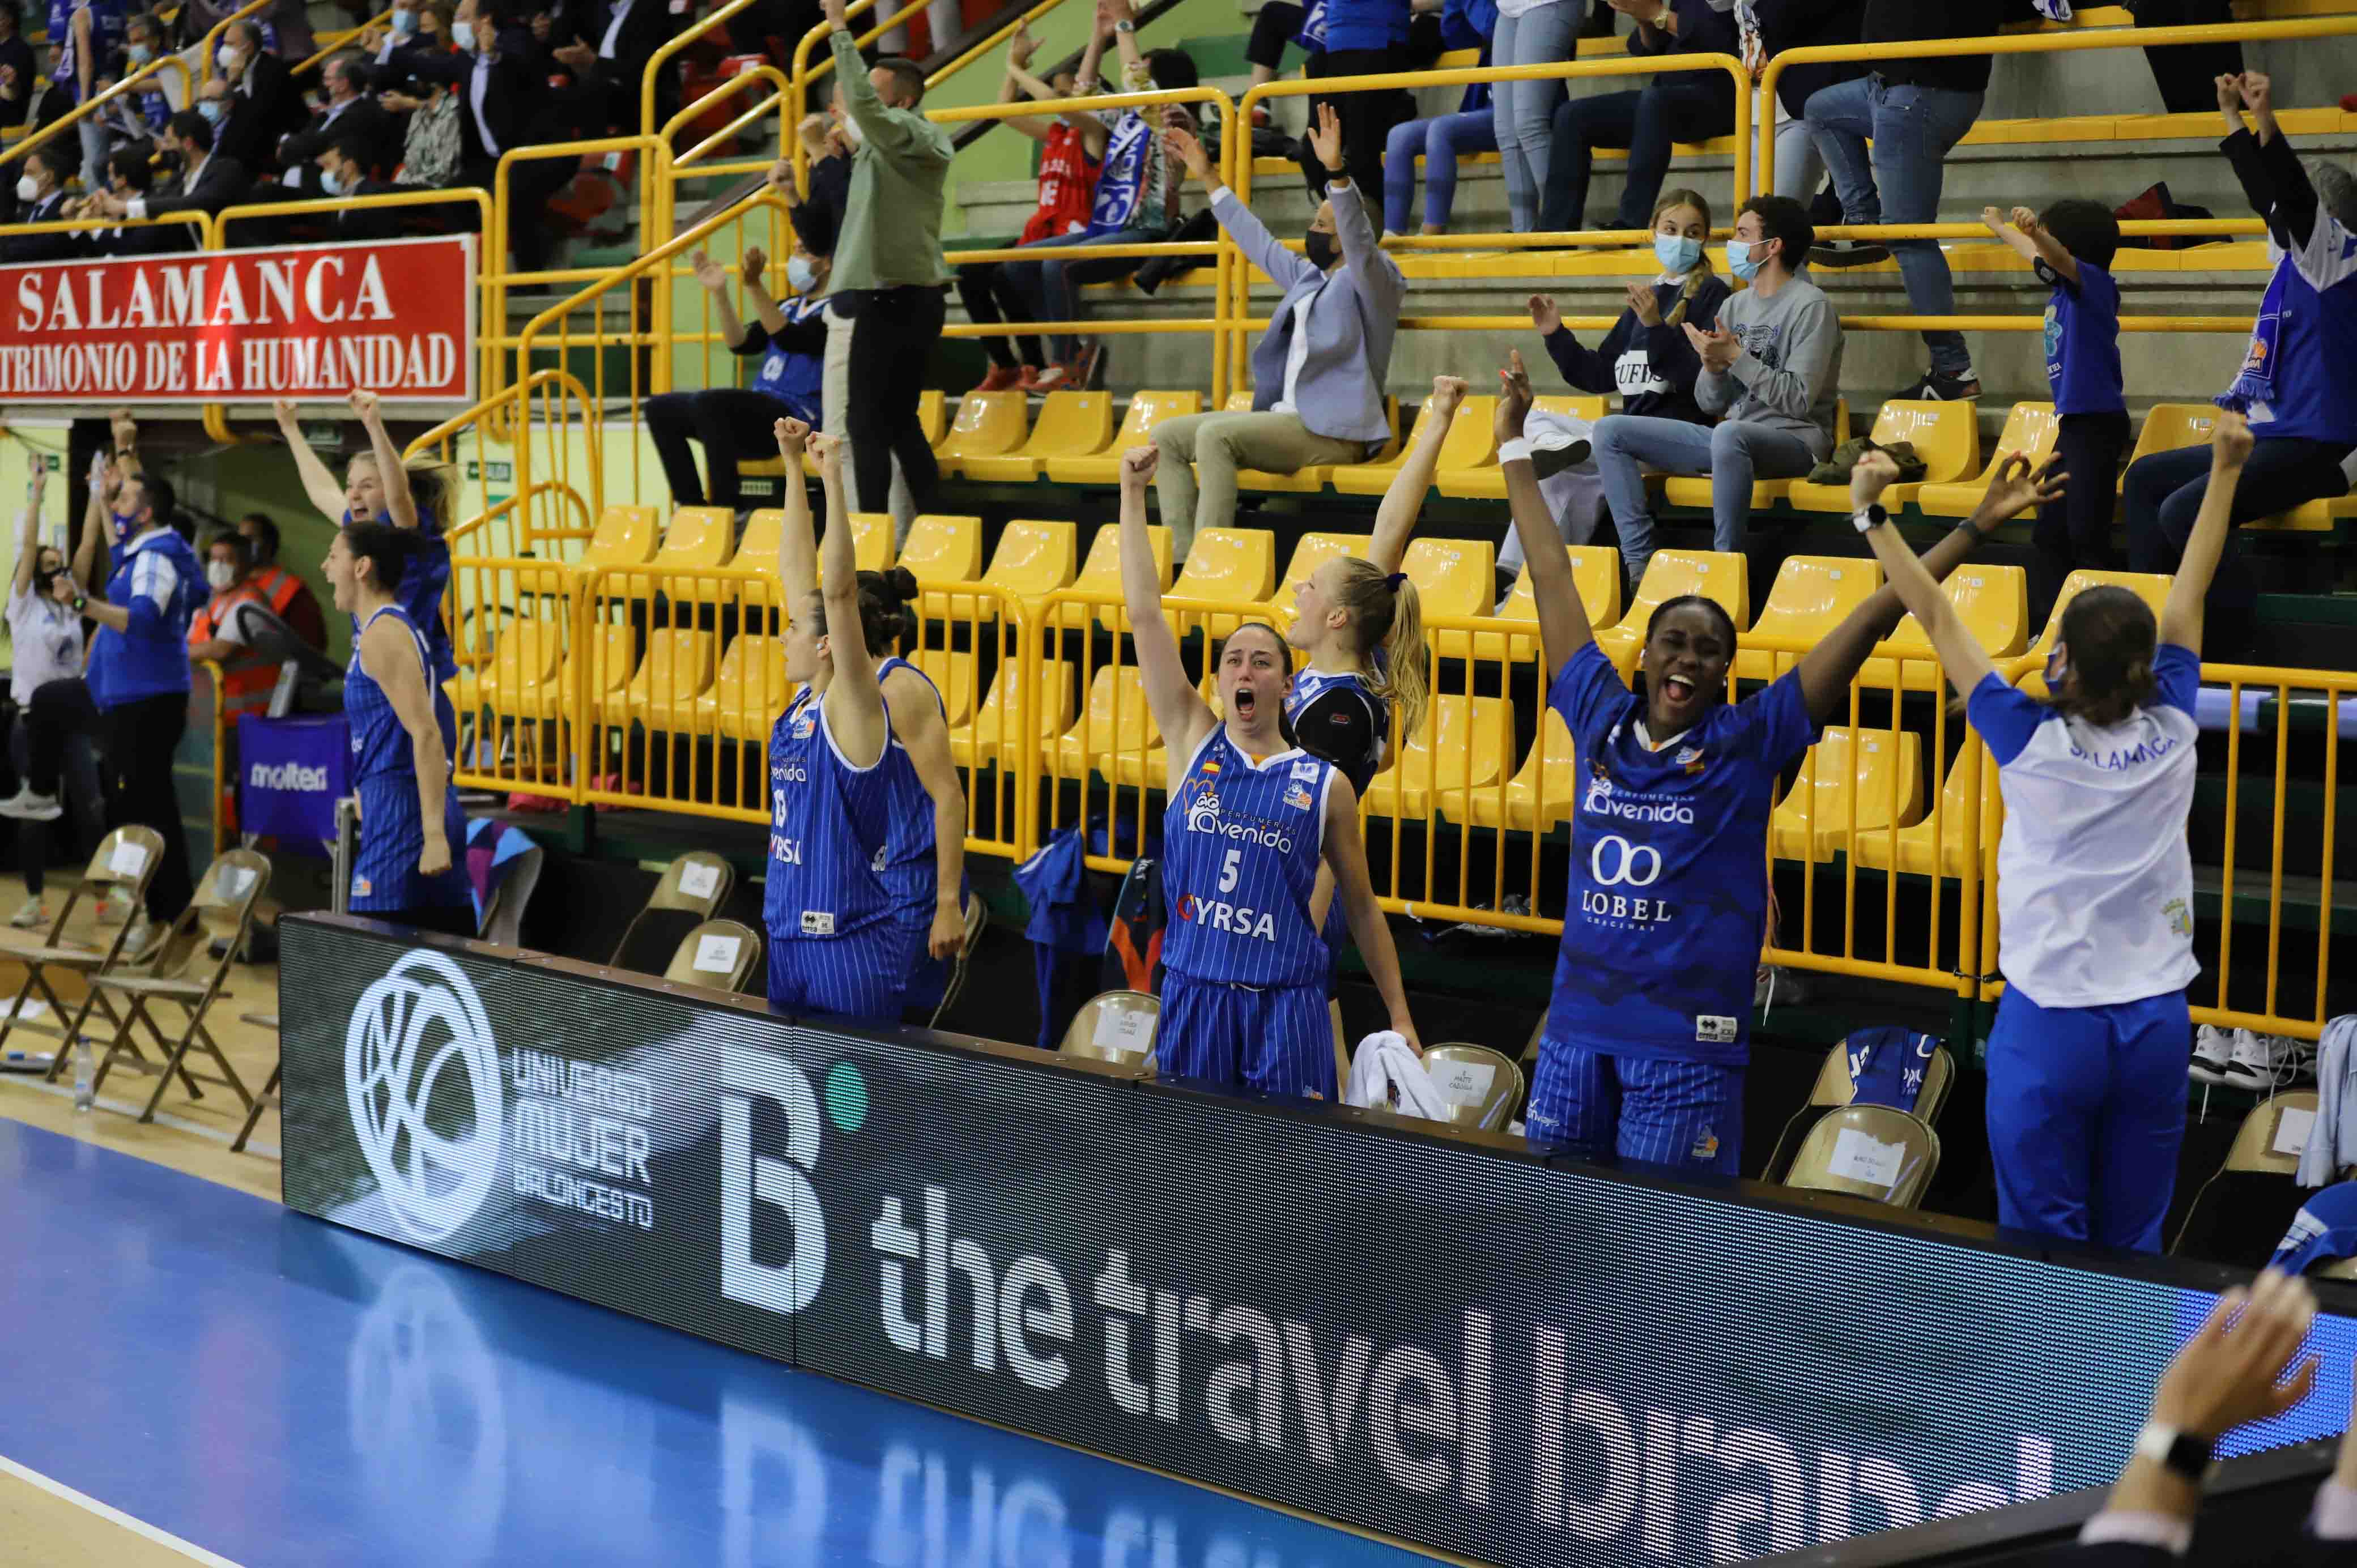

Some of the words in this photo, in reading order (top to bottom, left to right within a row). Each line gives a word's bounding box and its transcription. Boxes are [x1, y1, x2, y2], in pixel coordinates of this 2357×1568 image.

[18, 253, 395, 333] SALAMANCA
[144, 341, 188, 391] DE
[195, 339, 234, 391] LA
[242, 333, 457, 391] HUMANIDAD
[250, 762, 327, 791] molten
[1220, 808, 1296, 835] PERFUMERIAS
[770, 833, 802, 865] YRSA
[1219, 849, 1241, 893] 5
[1581, 889, 1671, 922] LOBEL
[514, 1099, 652, 1183] MUJER
[871, 1184, 1076, 1391] the
[1094, 1248, 1491, 1508] travel
